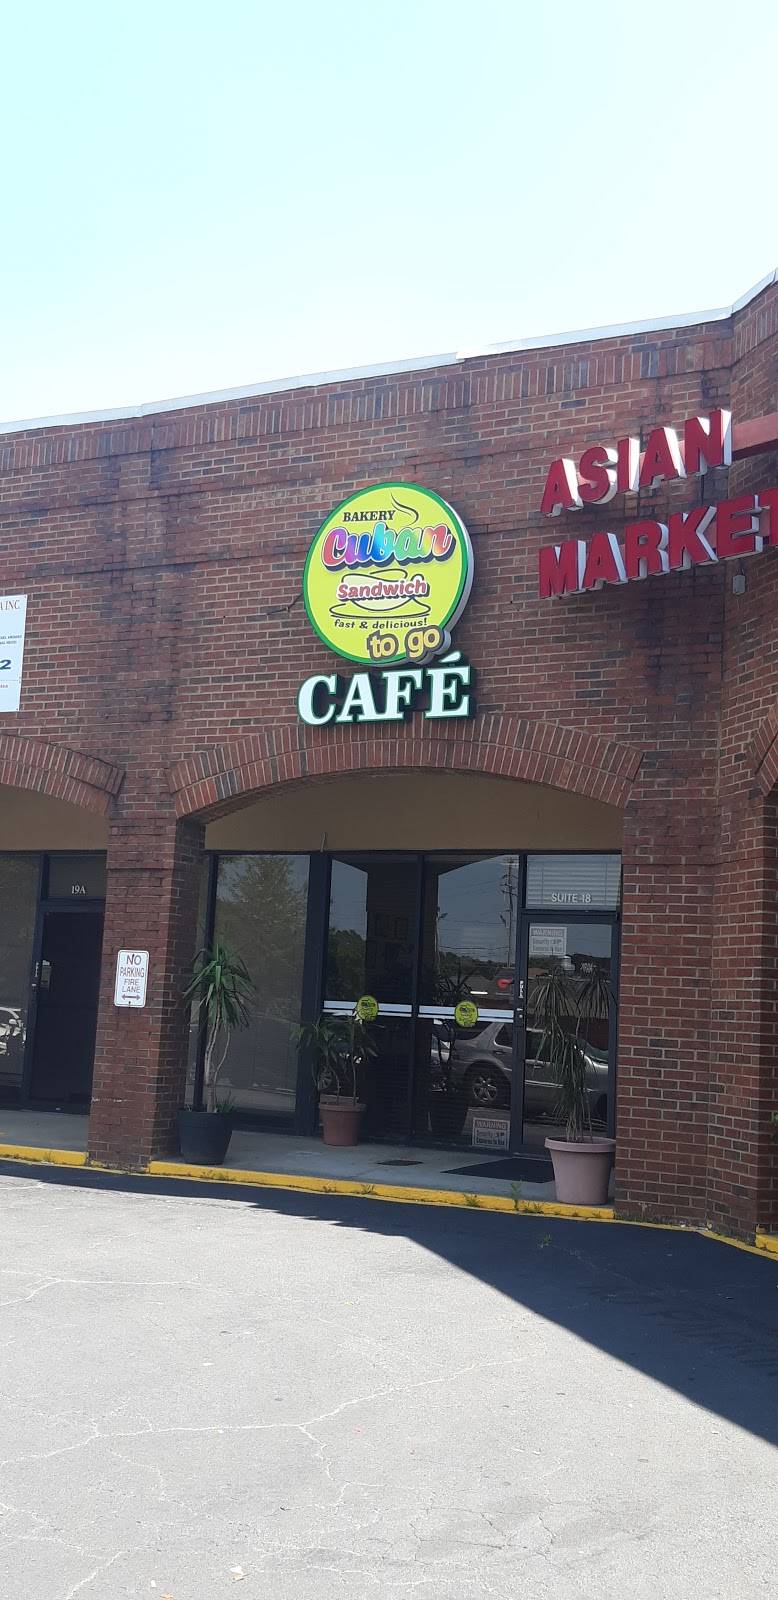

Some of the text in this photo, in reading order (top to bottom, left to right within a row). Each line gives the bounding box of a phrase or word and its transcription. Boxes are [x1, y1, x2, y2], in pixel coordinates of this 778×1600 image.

[540, 409, 732, 517] ASIAN
[342, 510, 396, 523] BAKERY
[322, 522, 456, 570] Cuban
[337, 579, 429, 601] Sandwich
[334, 617, 428, 630] fast & delicious!
[367, 625, 443, 661] to go
[297, 651, 471, 726] CAFÉ
[551, 892, 578, 903] SUITE
[126, 954, 142, 966] NO
[119, 966, 145, 978] PARKING
[124, 978, 140, 986] FIRE
